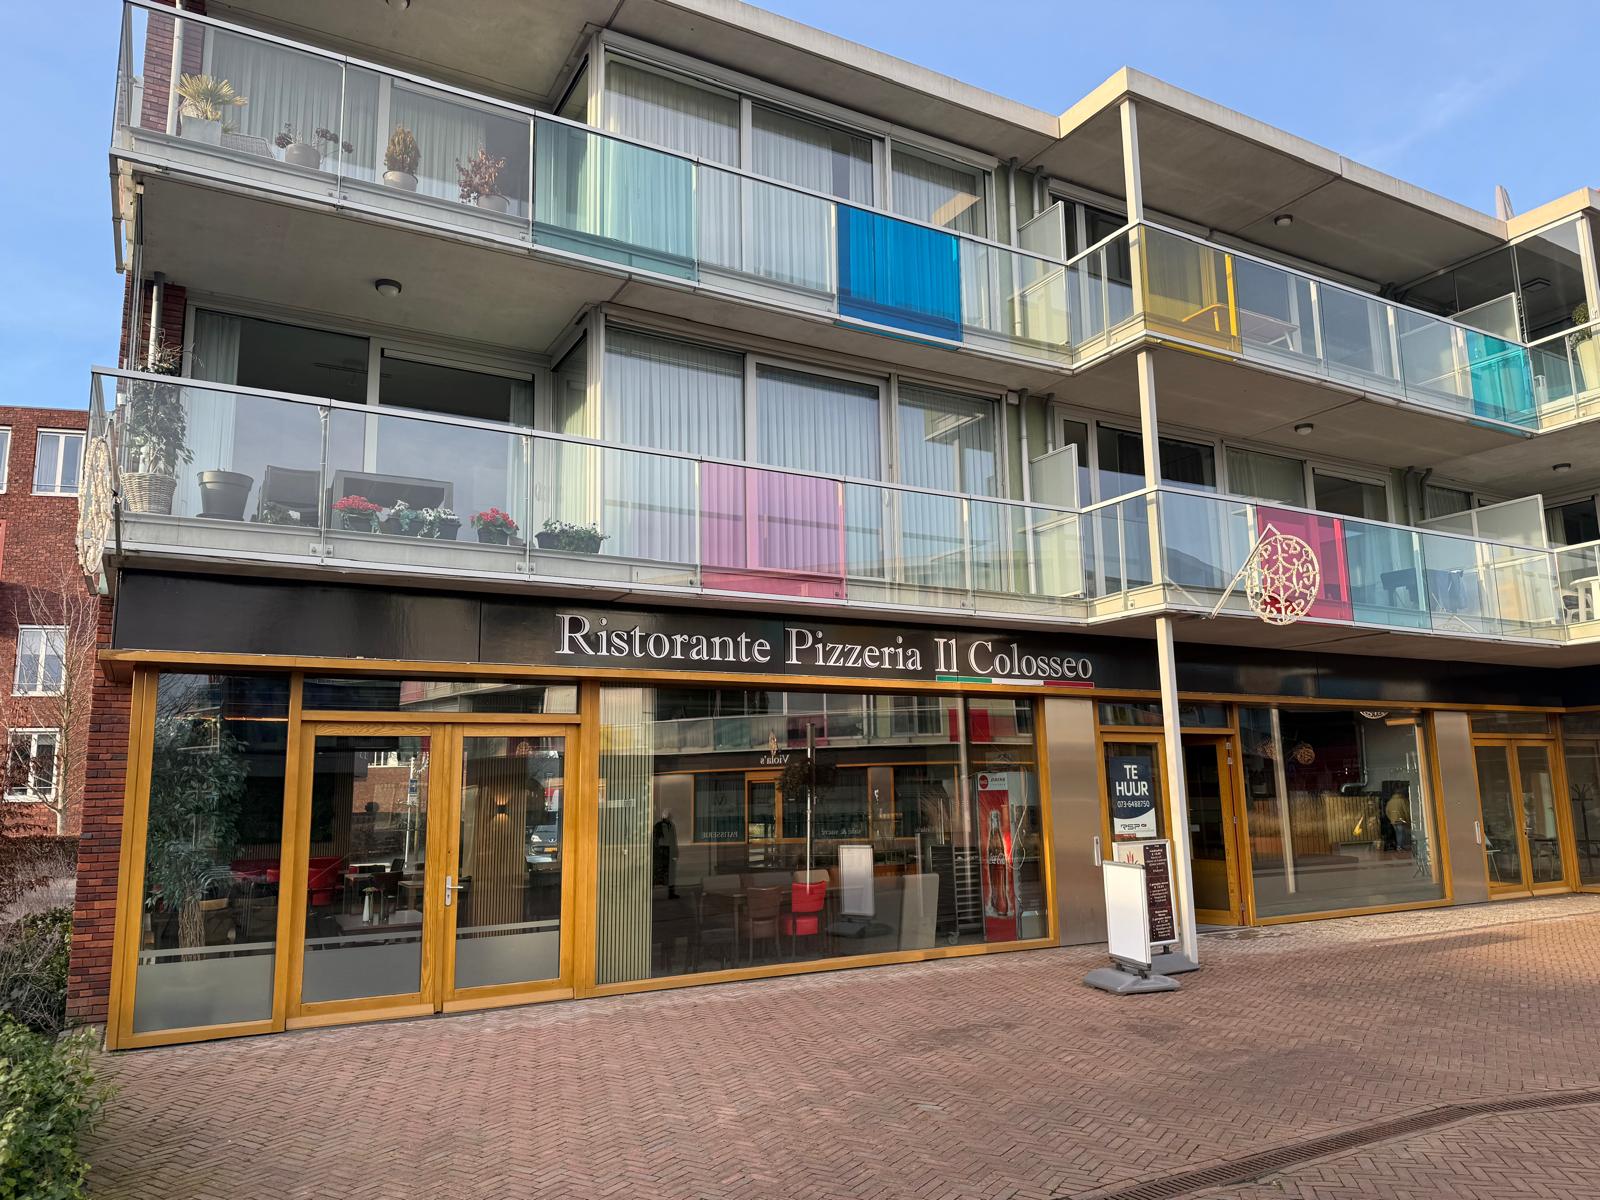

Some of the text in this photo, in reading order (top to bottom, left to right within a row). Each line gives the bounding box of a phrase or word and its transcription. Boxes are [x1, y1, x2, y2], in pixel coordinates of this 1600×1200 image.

[555, 613, 1094, 680] Ristorante Pizzeria Il Colosseo
[1123, 764, 1139, 780] TE
[1115, 781, 1149, 797] HUUR
